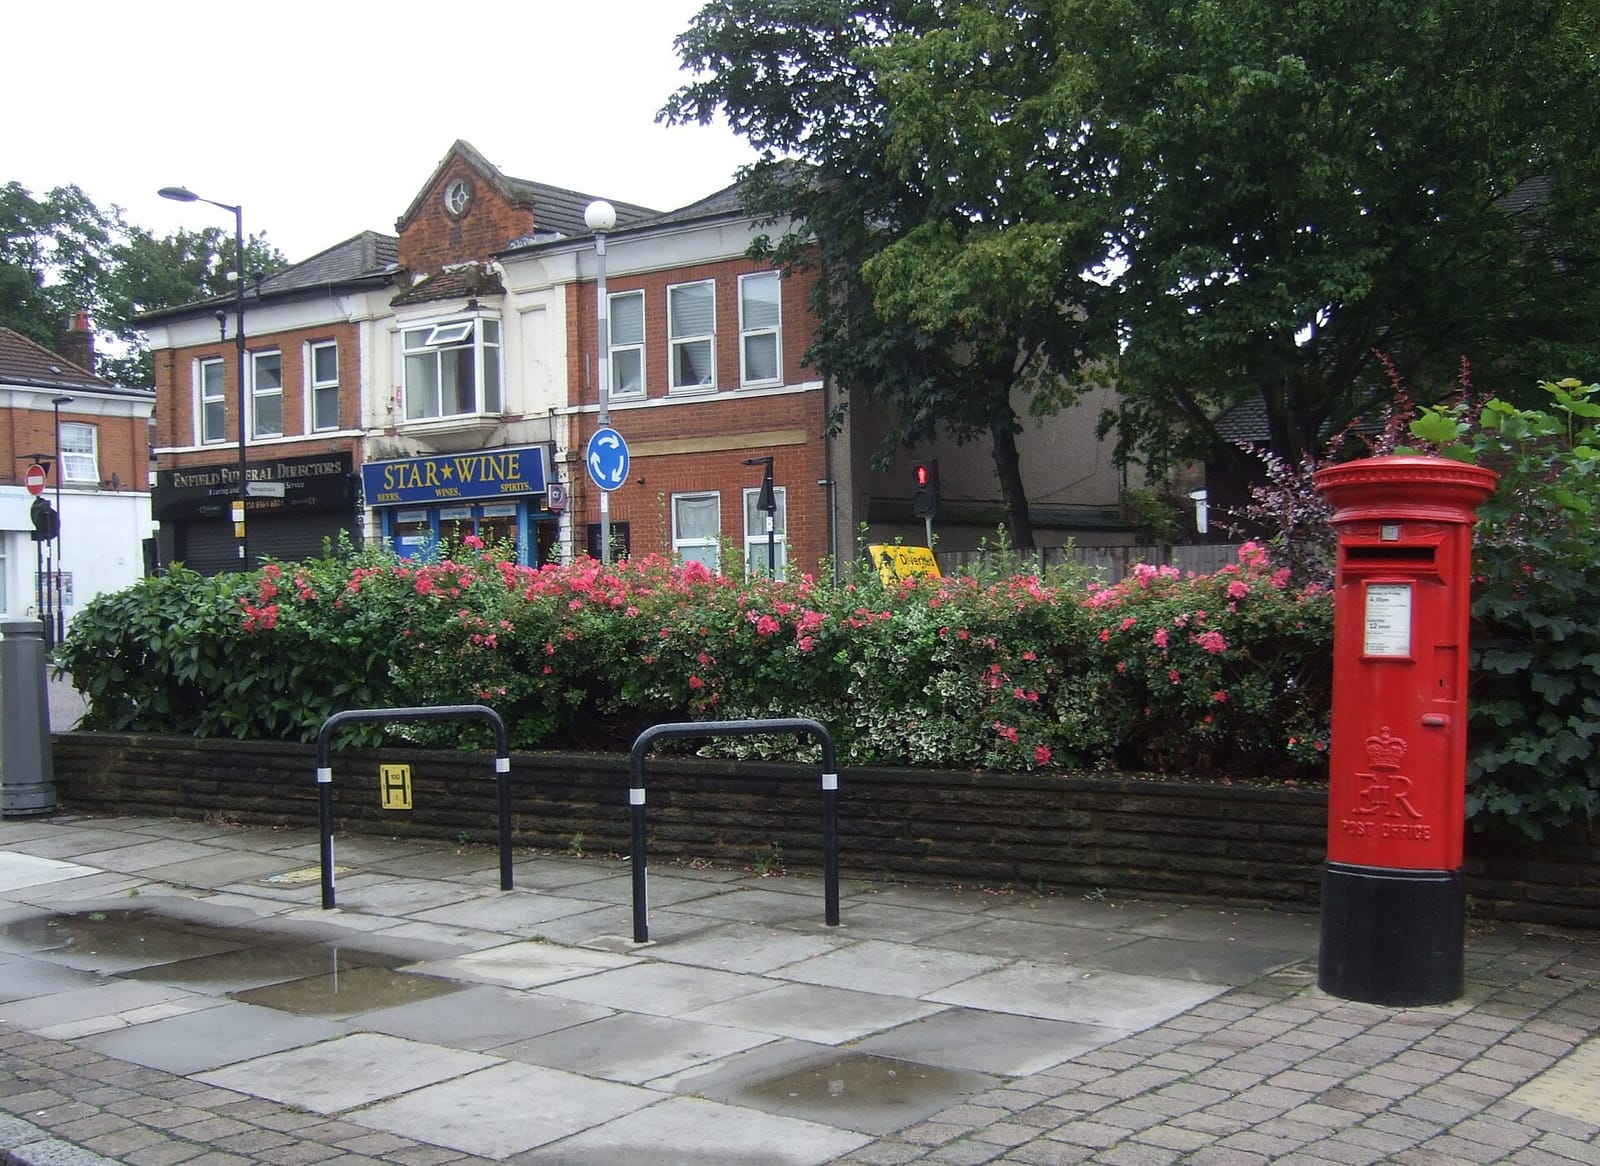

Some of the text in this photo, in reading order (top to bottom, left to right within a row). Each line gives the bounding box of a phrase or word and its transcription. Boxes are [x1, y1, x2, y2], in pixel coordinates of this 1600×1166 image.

[173, 472, 220, 488] ENFIELD
[276, 461, 342, 479] DIRECTORS
[383, 453, 521, 490] STAR WINE
[386, 770, 407, 804] H
[1341, 819, 1431, 841] POST OFFICE
